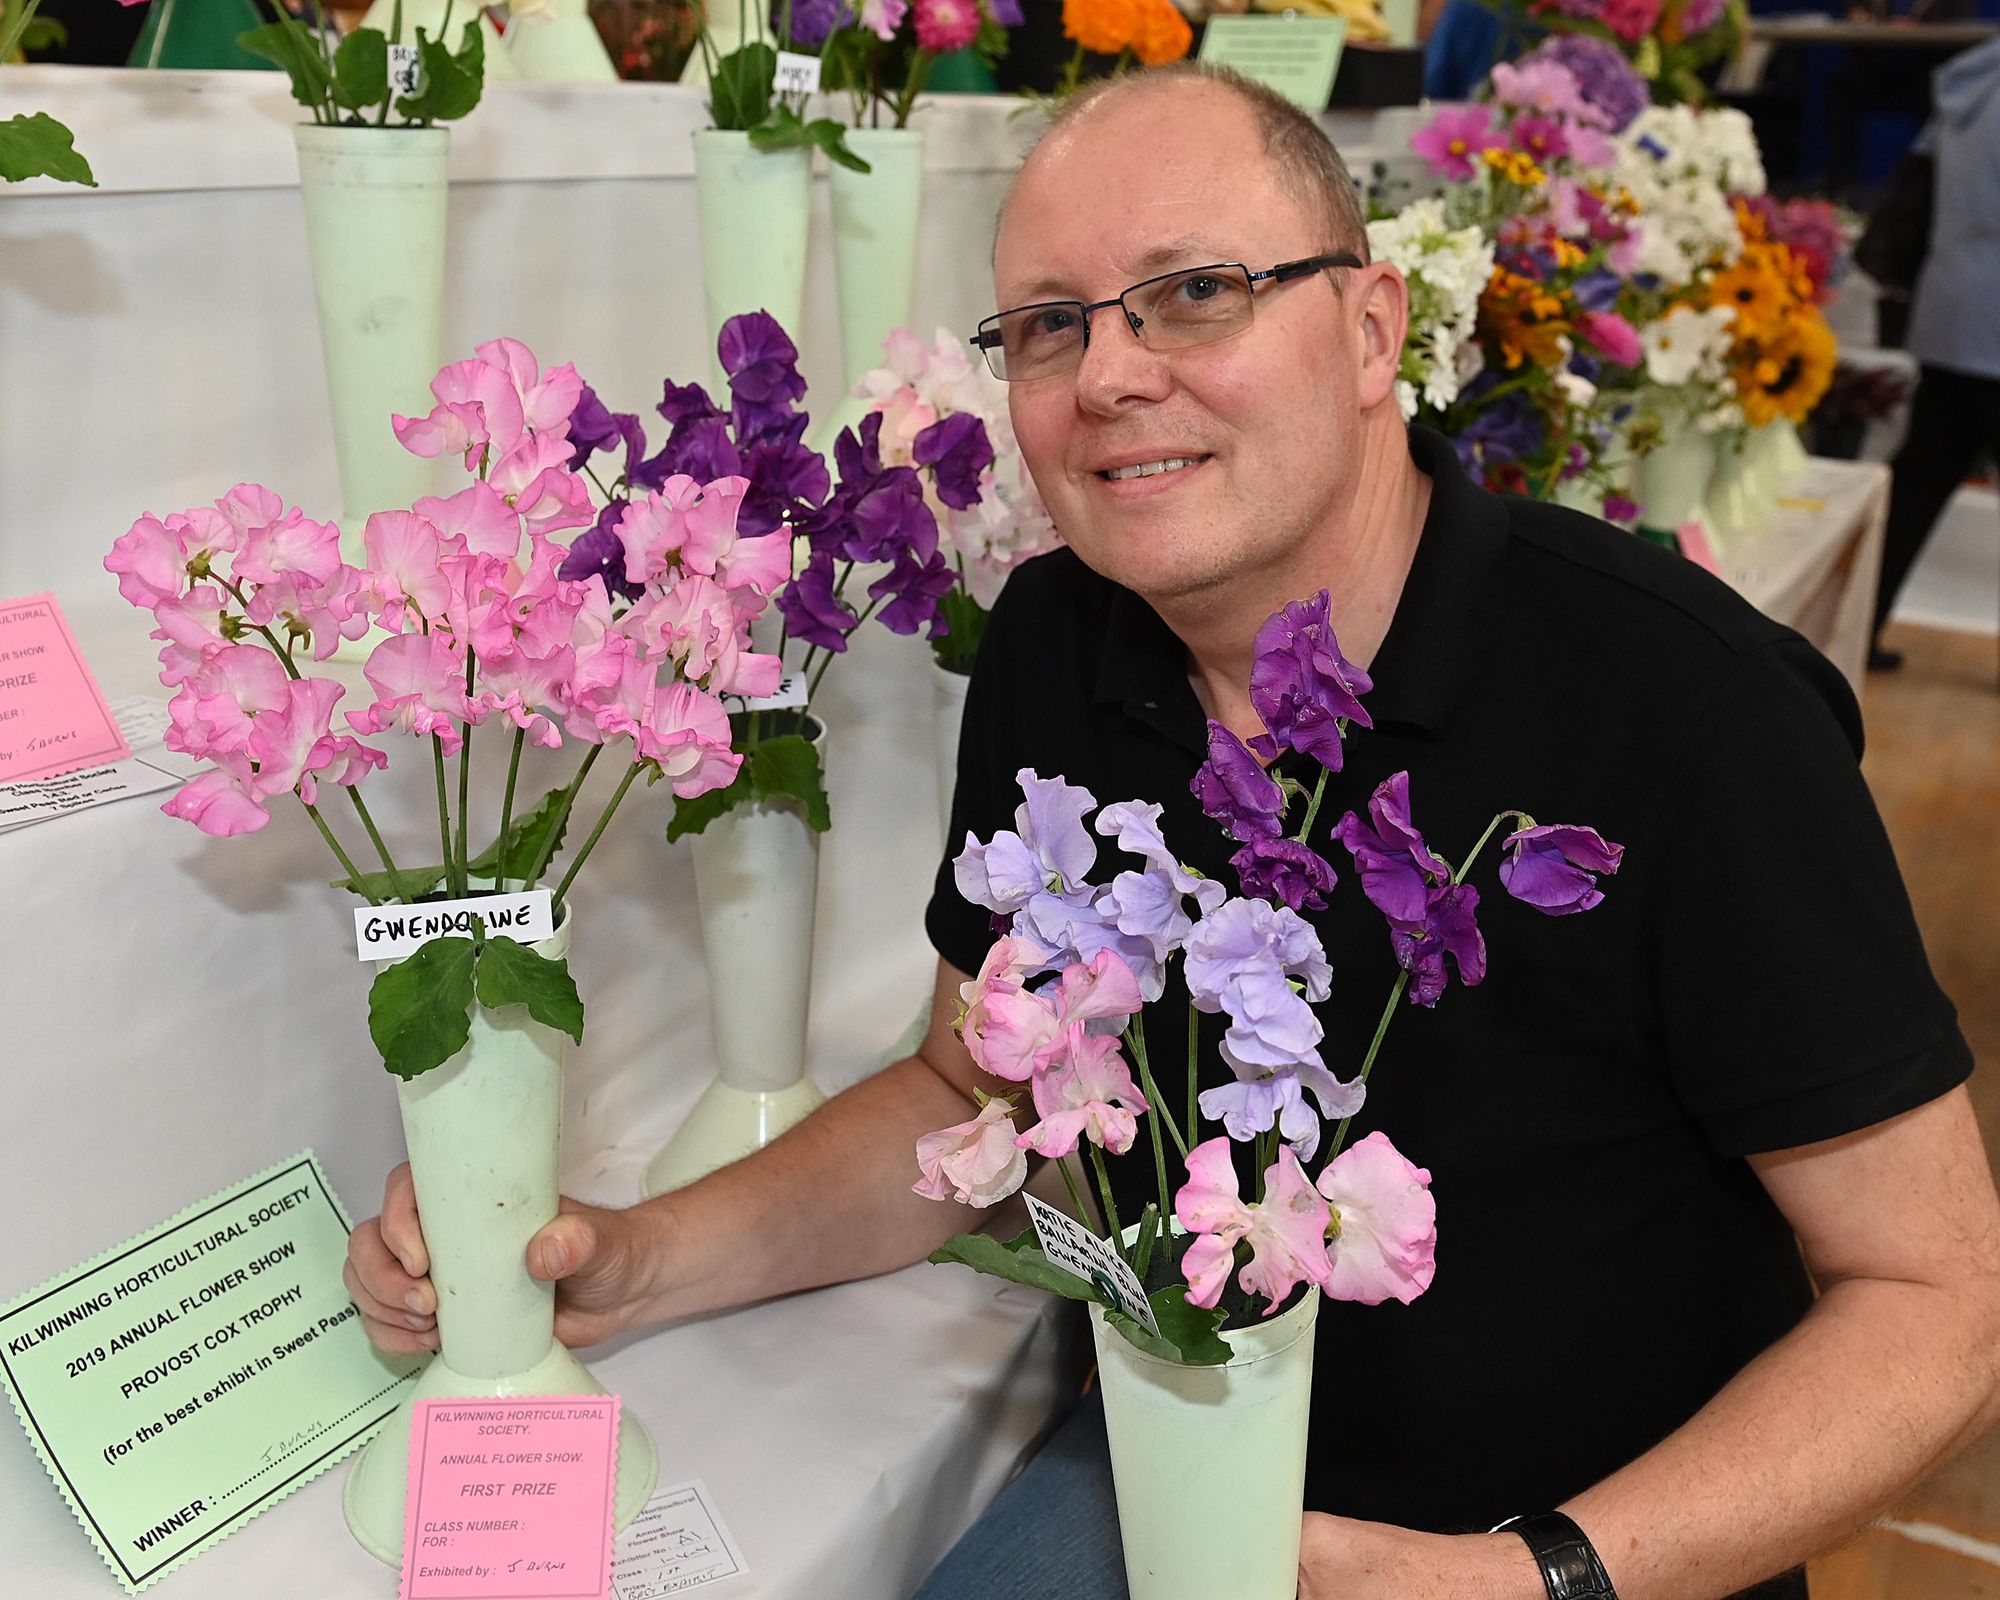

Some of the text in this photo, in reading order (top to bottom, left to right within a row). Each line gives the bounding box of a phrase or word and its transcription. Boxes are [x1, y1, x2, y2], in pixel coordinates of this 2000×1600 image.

[364, 904, 531, 943] GWENDOINE
[1031, 1200, 1129, 1279] KATIE ALICE
[8, 1186, 312, 1357] KILWINNING HORTICULTURAL SOCIETY
[65, 1241, 297, 1379] 2019 ANNUAL FLOWER SHOW
[120, 1285, 304, 1400] PROVOST COX TROPHY
[102, 1434, 133, 1466] (for
[135, 1418, 165, 1447] the
[164, 1395, 203, 1426] best
[203, 1361, 257, 1404] exhibit
[256, 1352, 273, 1372] in
[273, 1330, 318, 1361] Sweet
[434, 1409, 606, 1423] KILWINNING HORTICULTURAL
[440, 1453, 488, 1465] ANNUAL
[491, 1452, 543, 1465] FLOWER
[460, 1482, 557, 1497] FIRST PRIZE
[133, 1497, 209, 1554] WINNER
[424, 1520, 464, 1533] CLASS
[466, 1520, 518, 1532] NUMBER
[635, 1526, 667, 1538] Annual
[422, 1536, 448, 1548] FOR
[627, 1528, 685, 1548] Flower Show
[419, 1565, 473, 1578] Exhibited
[475, 1564, 489, 1579] by
[616, 1569, 642, 1581] Class
[622, 1583, 646, 1594] Prize
